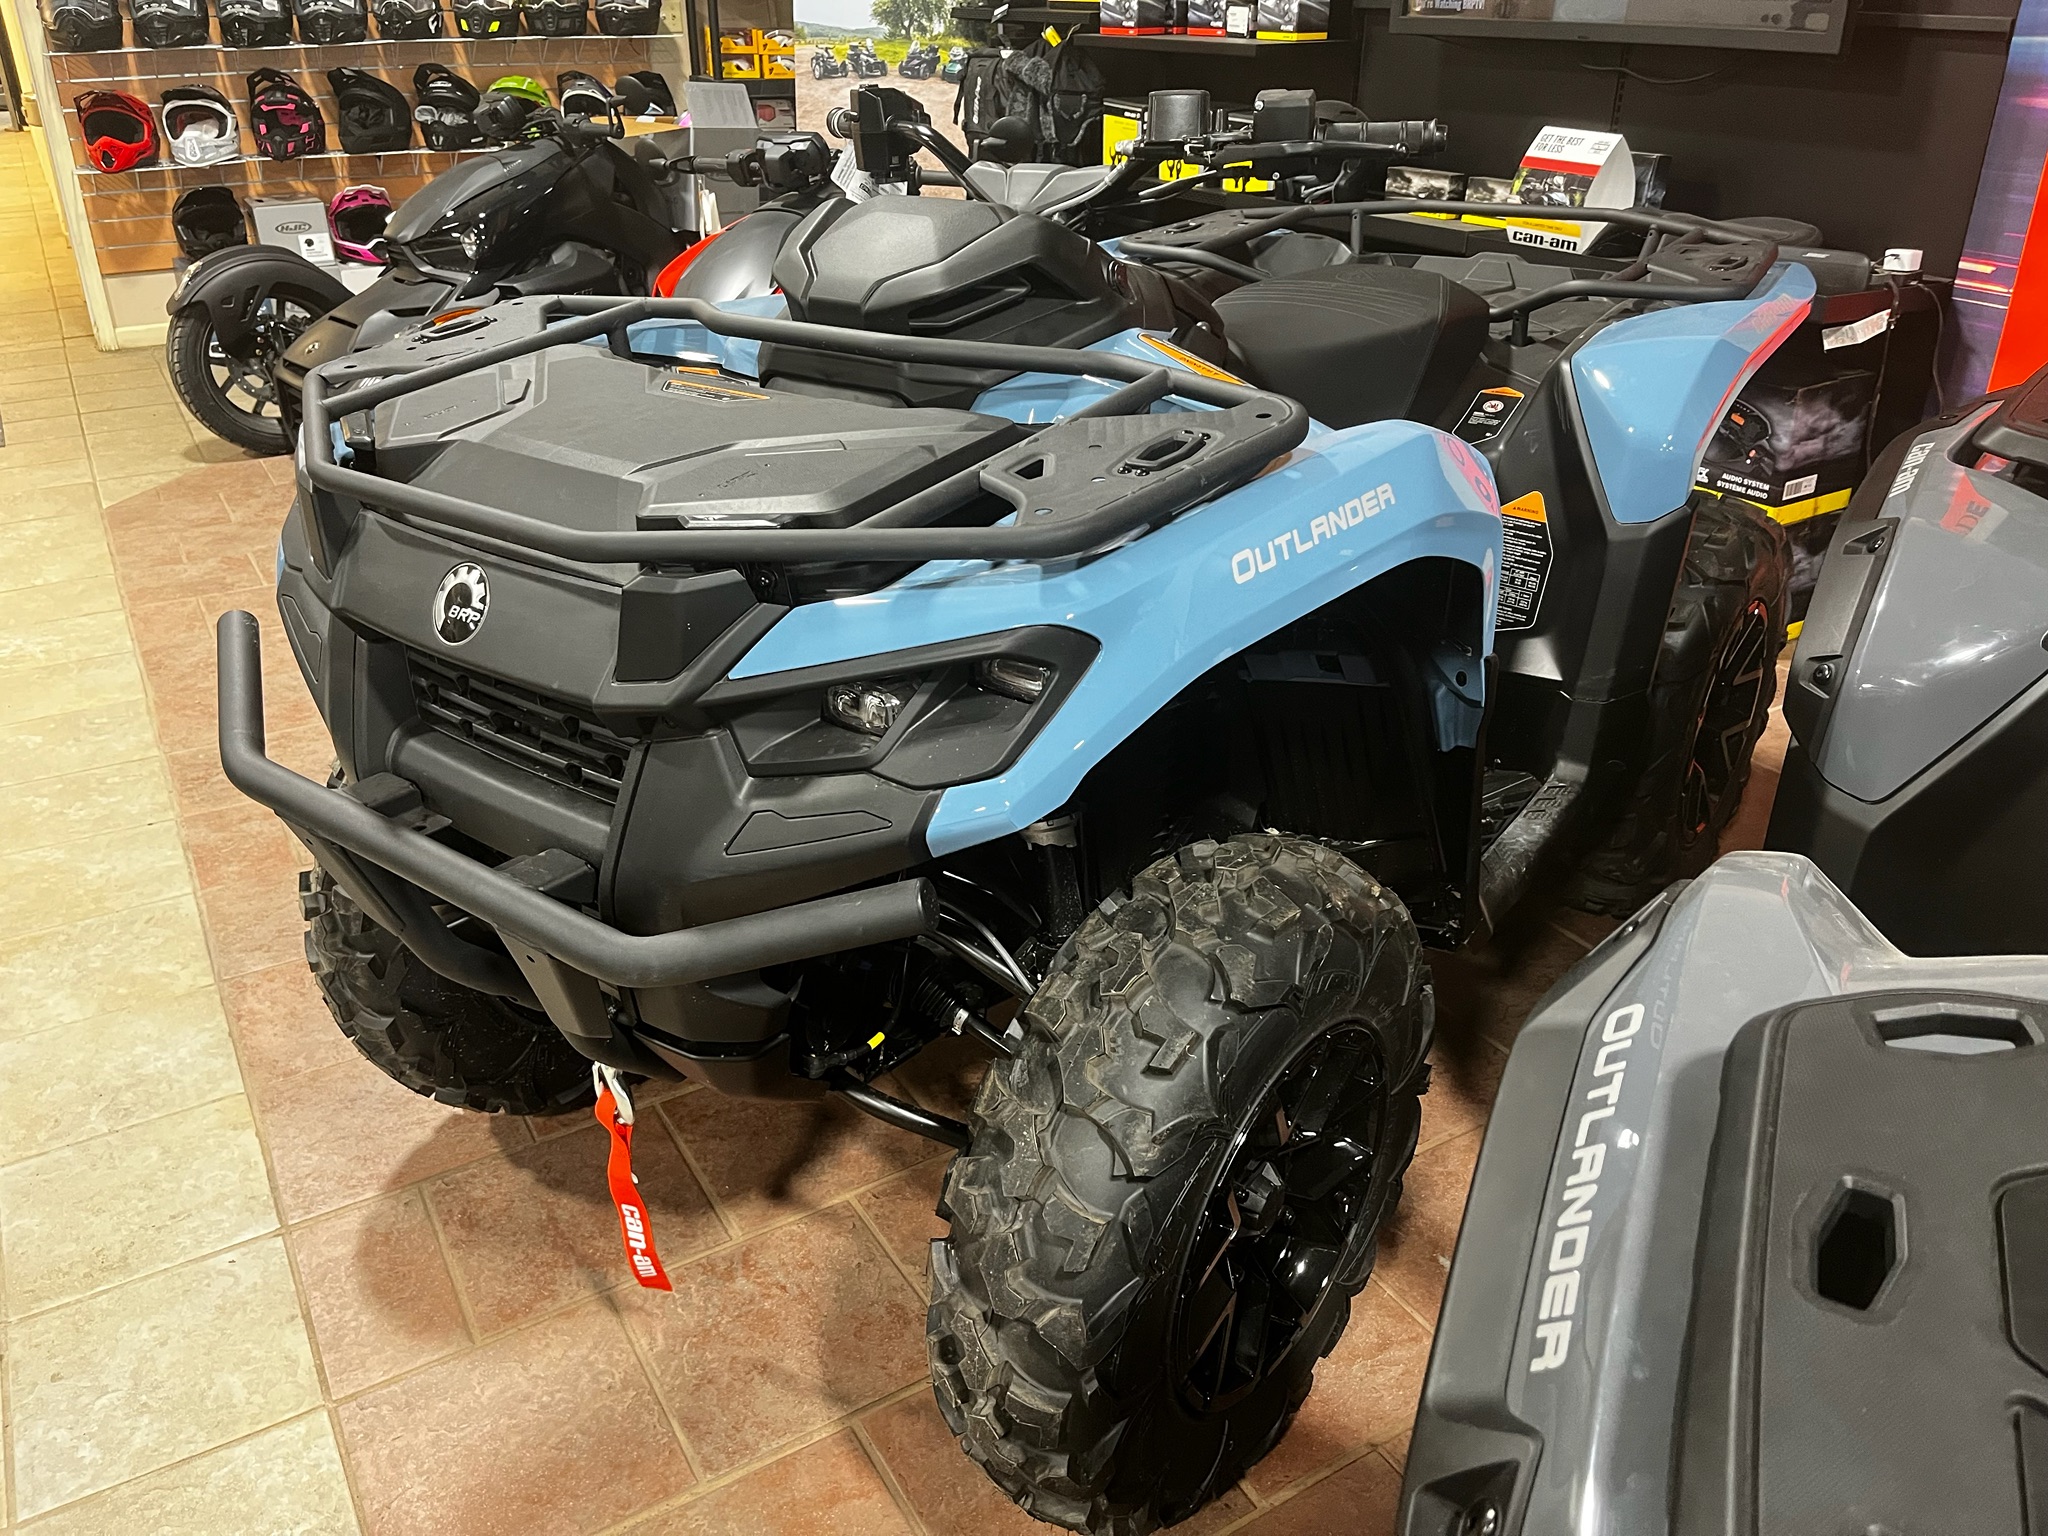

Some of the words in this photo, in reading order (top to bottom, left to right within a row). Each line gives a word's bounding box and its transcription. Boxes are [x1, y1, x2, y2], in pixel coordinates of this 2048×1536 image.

[1534, 142, 1549, 151] FOR
[1547, 143, 1566, 153] LESS
[1540, 133, 1555, 143] GET
[1553, 135, 1568, 145] THE
[1566, 136, 1585, 147] BEST
[1512, 230, 1578, 251] can-am
[1888, 442, 1936, 498] can-am
[1721, 472, 1743, 484] AUDIO
[1743, 478, 1770, 491] SYSTEM
[1746, 488, 1768, 500] AUDIO
[1231, 482, 1396, 585] OUTLANDER
[448, 604, 481, 624] BRP
[1530, 1002, 1646, 1373] OUTLANDER
[620, 1203, 658, 1278] can-am
